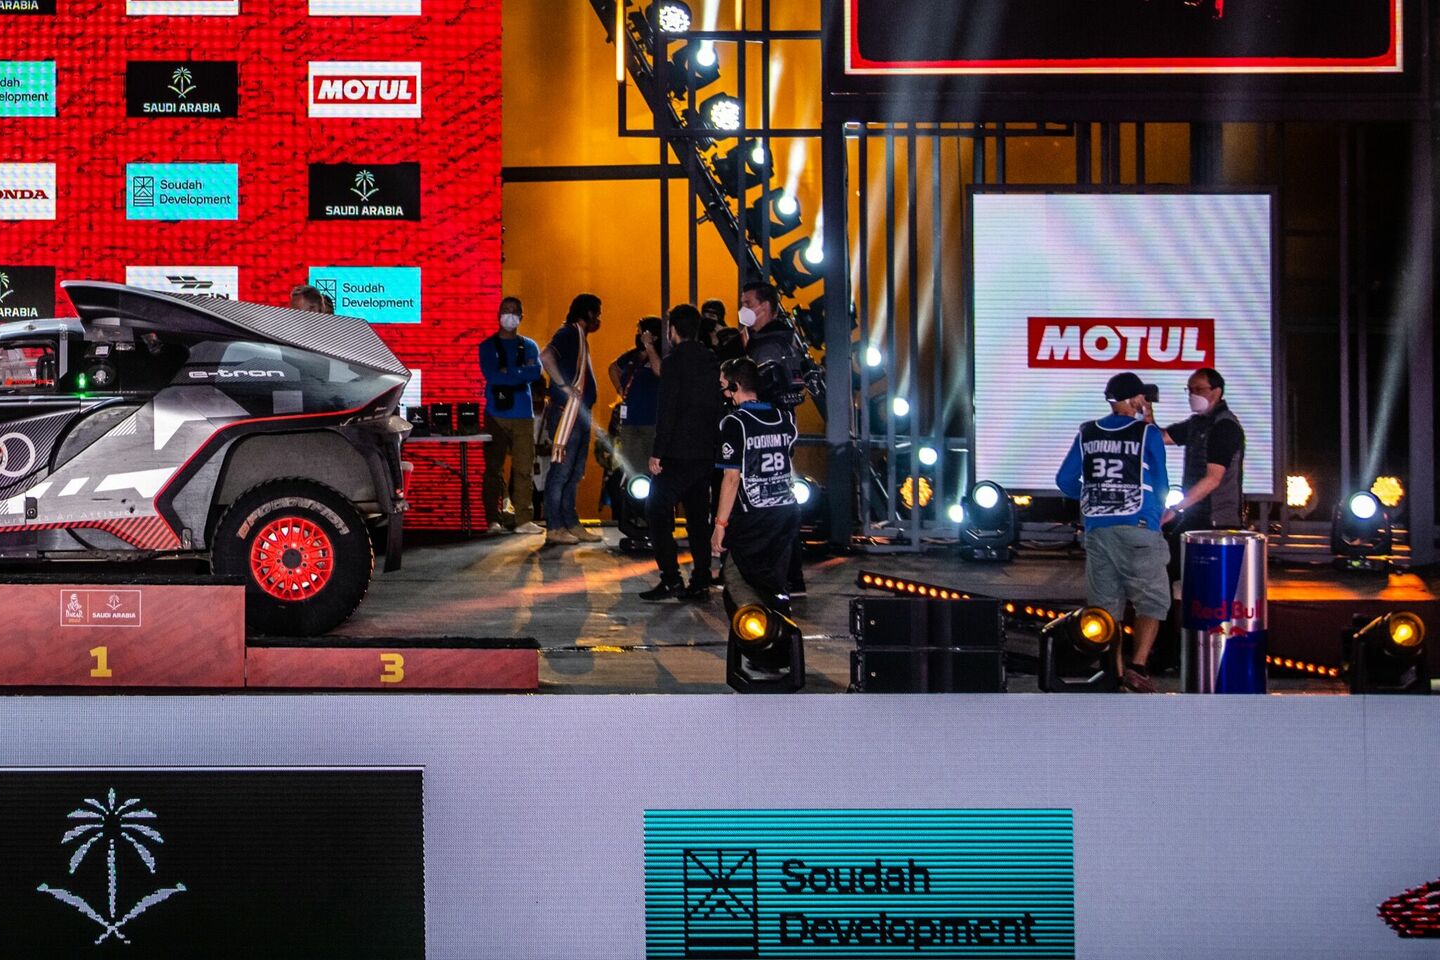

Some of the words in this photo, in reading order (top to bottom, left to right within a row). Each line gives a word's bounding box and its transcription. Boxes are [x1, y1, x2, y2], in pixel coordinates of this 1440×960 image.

[317, 79, 412, 100] MOTUL
[143, 103, 176, 113] SAUDI
[179, 103, 221, 113] ARABIA
[160, 179, 203, 190] Soudah
[160, 194, 231, 206] Development
[325, 205, 359, 215] SAUDI
[362, 205, 404, 215] ARABIA
[343, 282, 385, 293] Soudah
[342, 297, 414, 310] Development
[1036, 325, 1207, 363] MOTUL
[188, 369, 285, 378] e-tron
[1083, 440, 1122, 455] PODIUM
[1124, 441, 1140, 455] TV
[761, 452, 785, 472] 28
[1091, 458, 1124, 478] 32
[89, 646, 113, 677] 1
[380, 653, 405, 683] 3
[780, 857, 931, 895] Soudah
[780, 911, 1037, 952] Development
